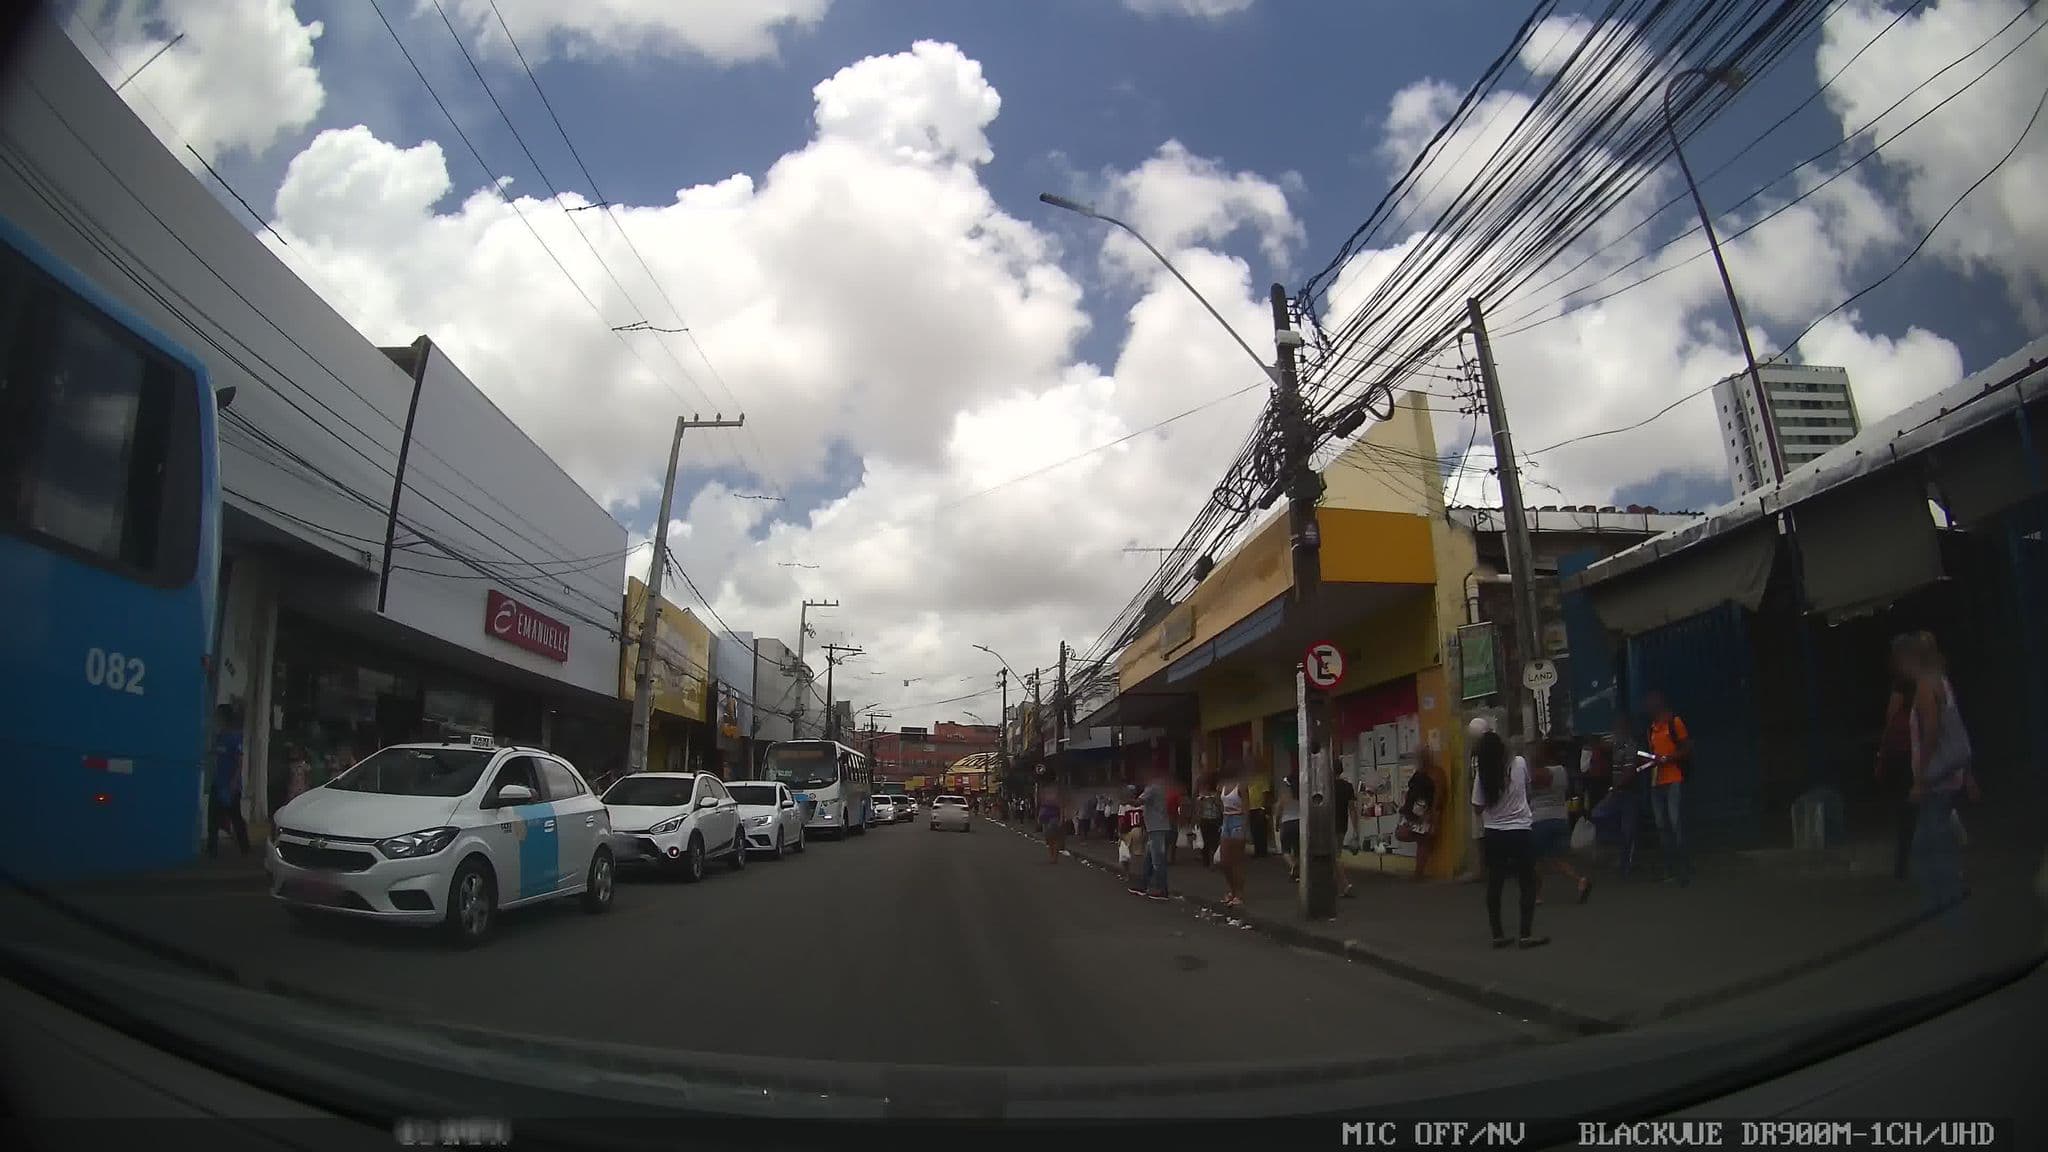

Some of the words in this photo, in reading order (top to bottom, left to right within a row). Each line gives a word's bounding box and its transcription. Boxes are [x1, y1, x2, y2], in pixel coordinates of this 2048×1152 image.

[517, 614, 568, 654] EMANUELLE
[85, 647, 145, 697] 082
[1317, 651, 1332, 680] E
[1528, 672, 1553, 682] LAND
